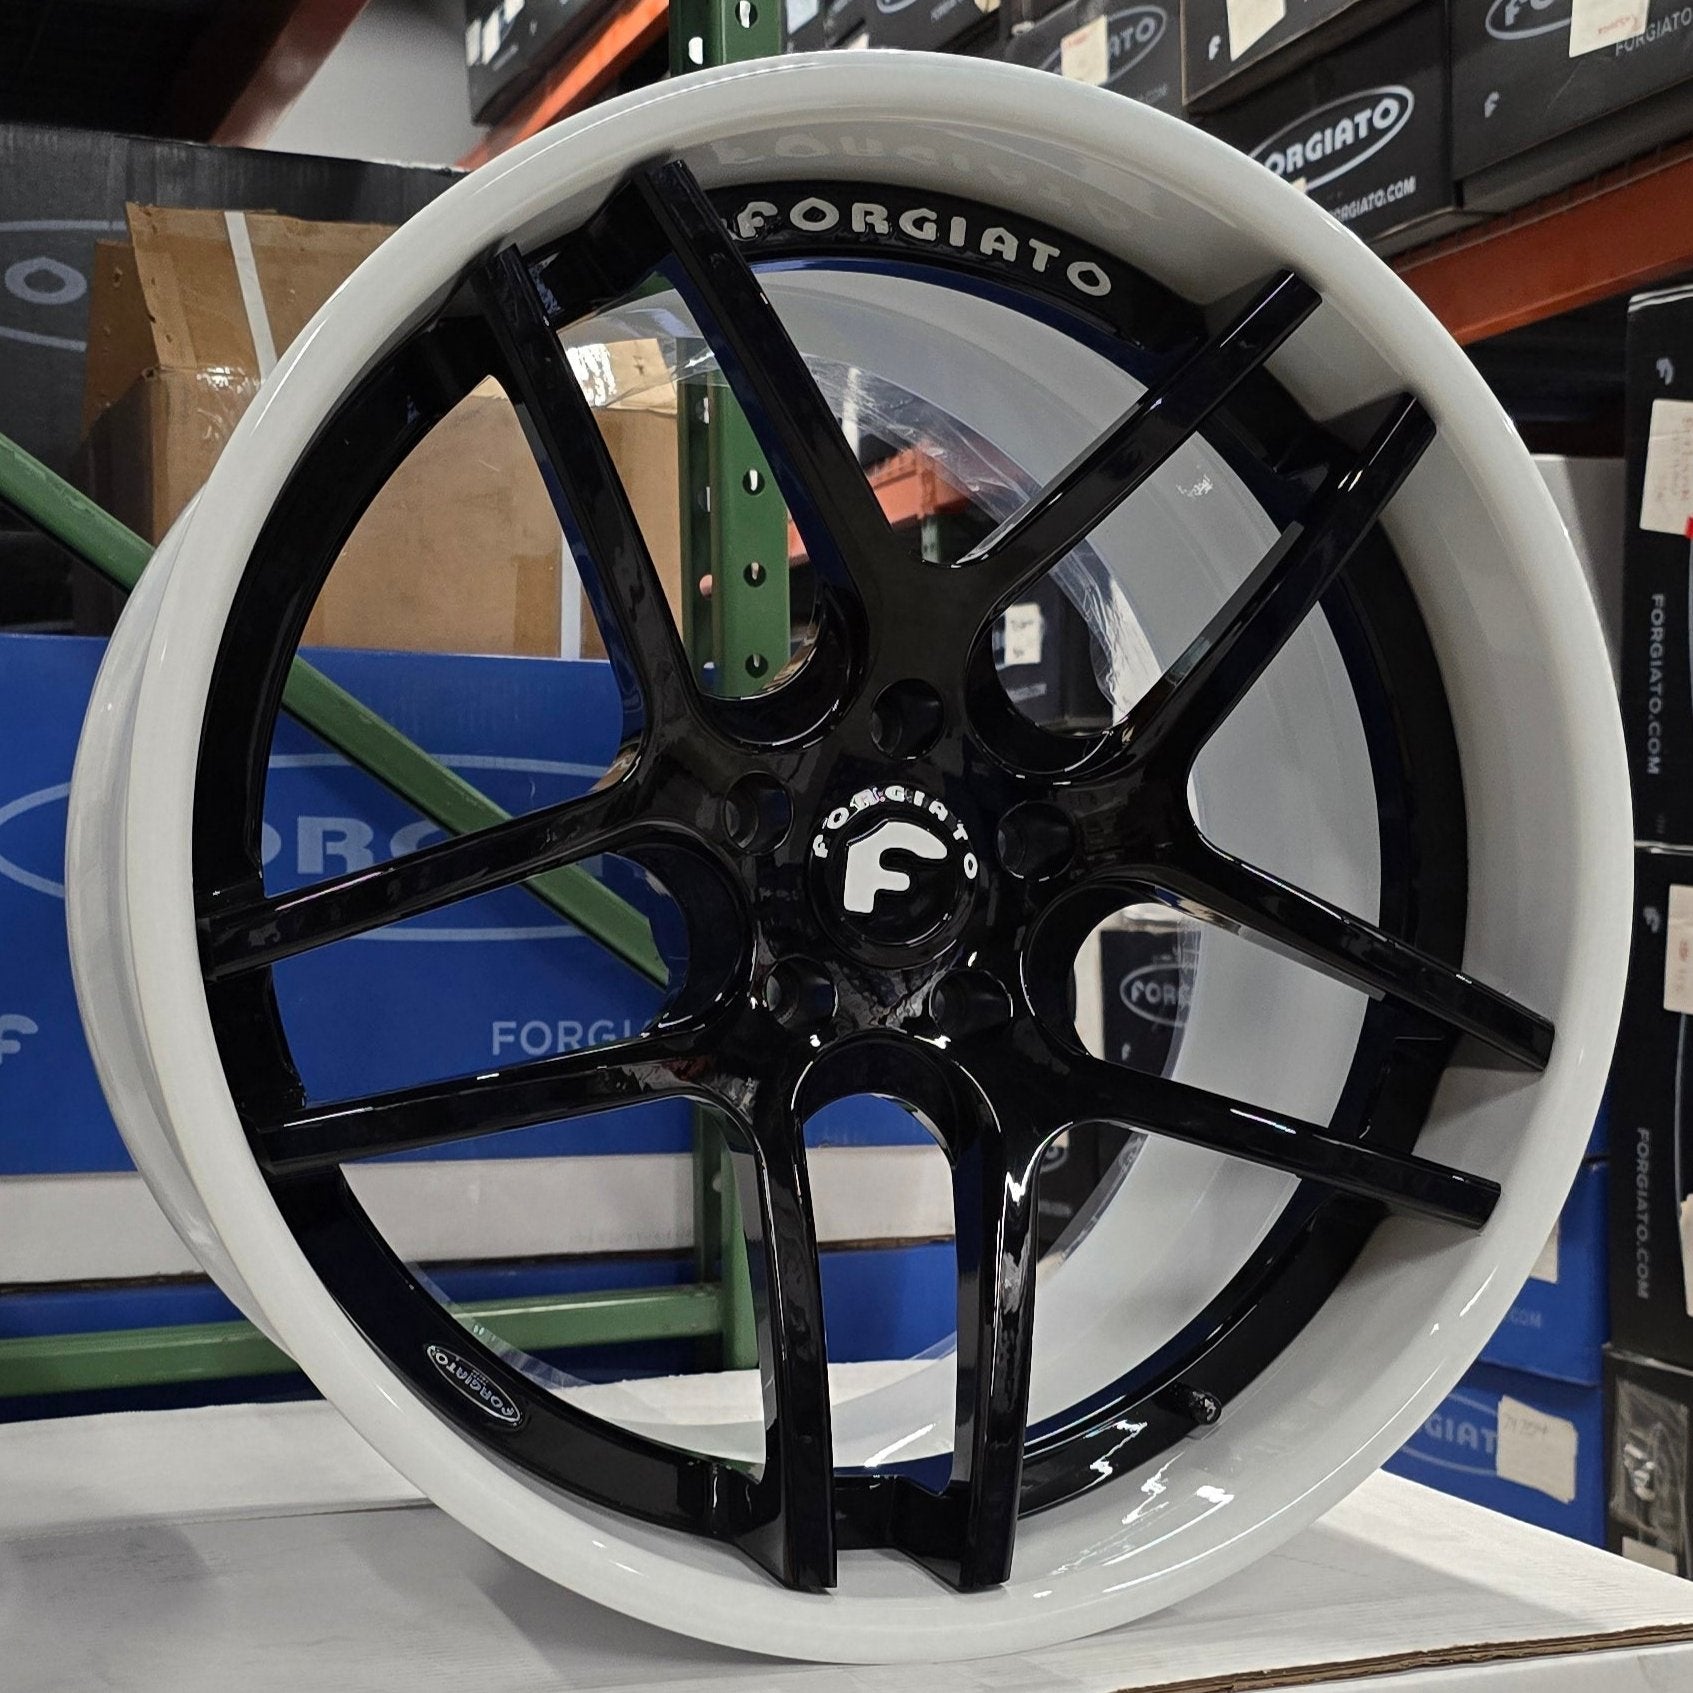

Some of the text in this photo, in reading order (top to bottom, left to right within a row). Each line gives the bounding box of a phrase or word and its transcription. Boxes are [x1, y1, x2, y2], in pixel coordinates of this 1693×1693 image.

[1264, 97, 1399, 176] ORGIATO
[1330, 175, 1416, 221] ORGIATO.COM
[736, 197, 1112, 297] FORGIATO
[1647, 594, 1665, 775] FORGIATO.COM
[812, 785, 979, 880] FORGIATO
[492, 1018, 650, 1056] FORGI
[1637, 1127, 1650, 1299] FORGIATO.COM
[435, 1352, 515, 1416] FORGIATO
[1424, 1414, 1498, 1453] GIAT
